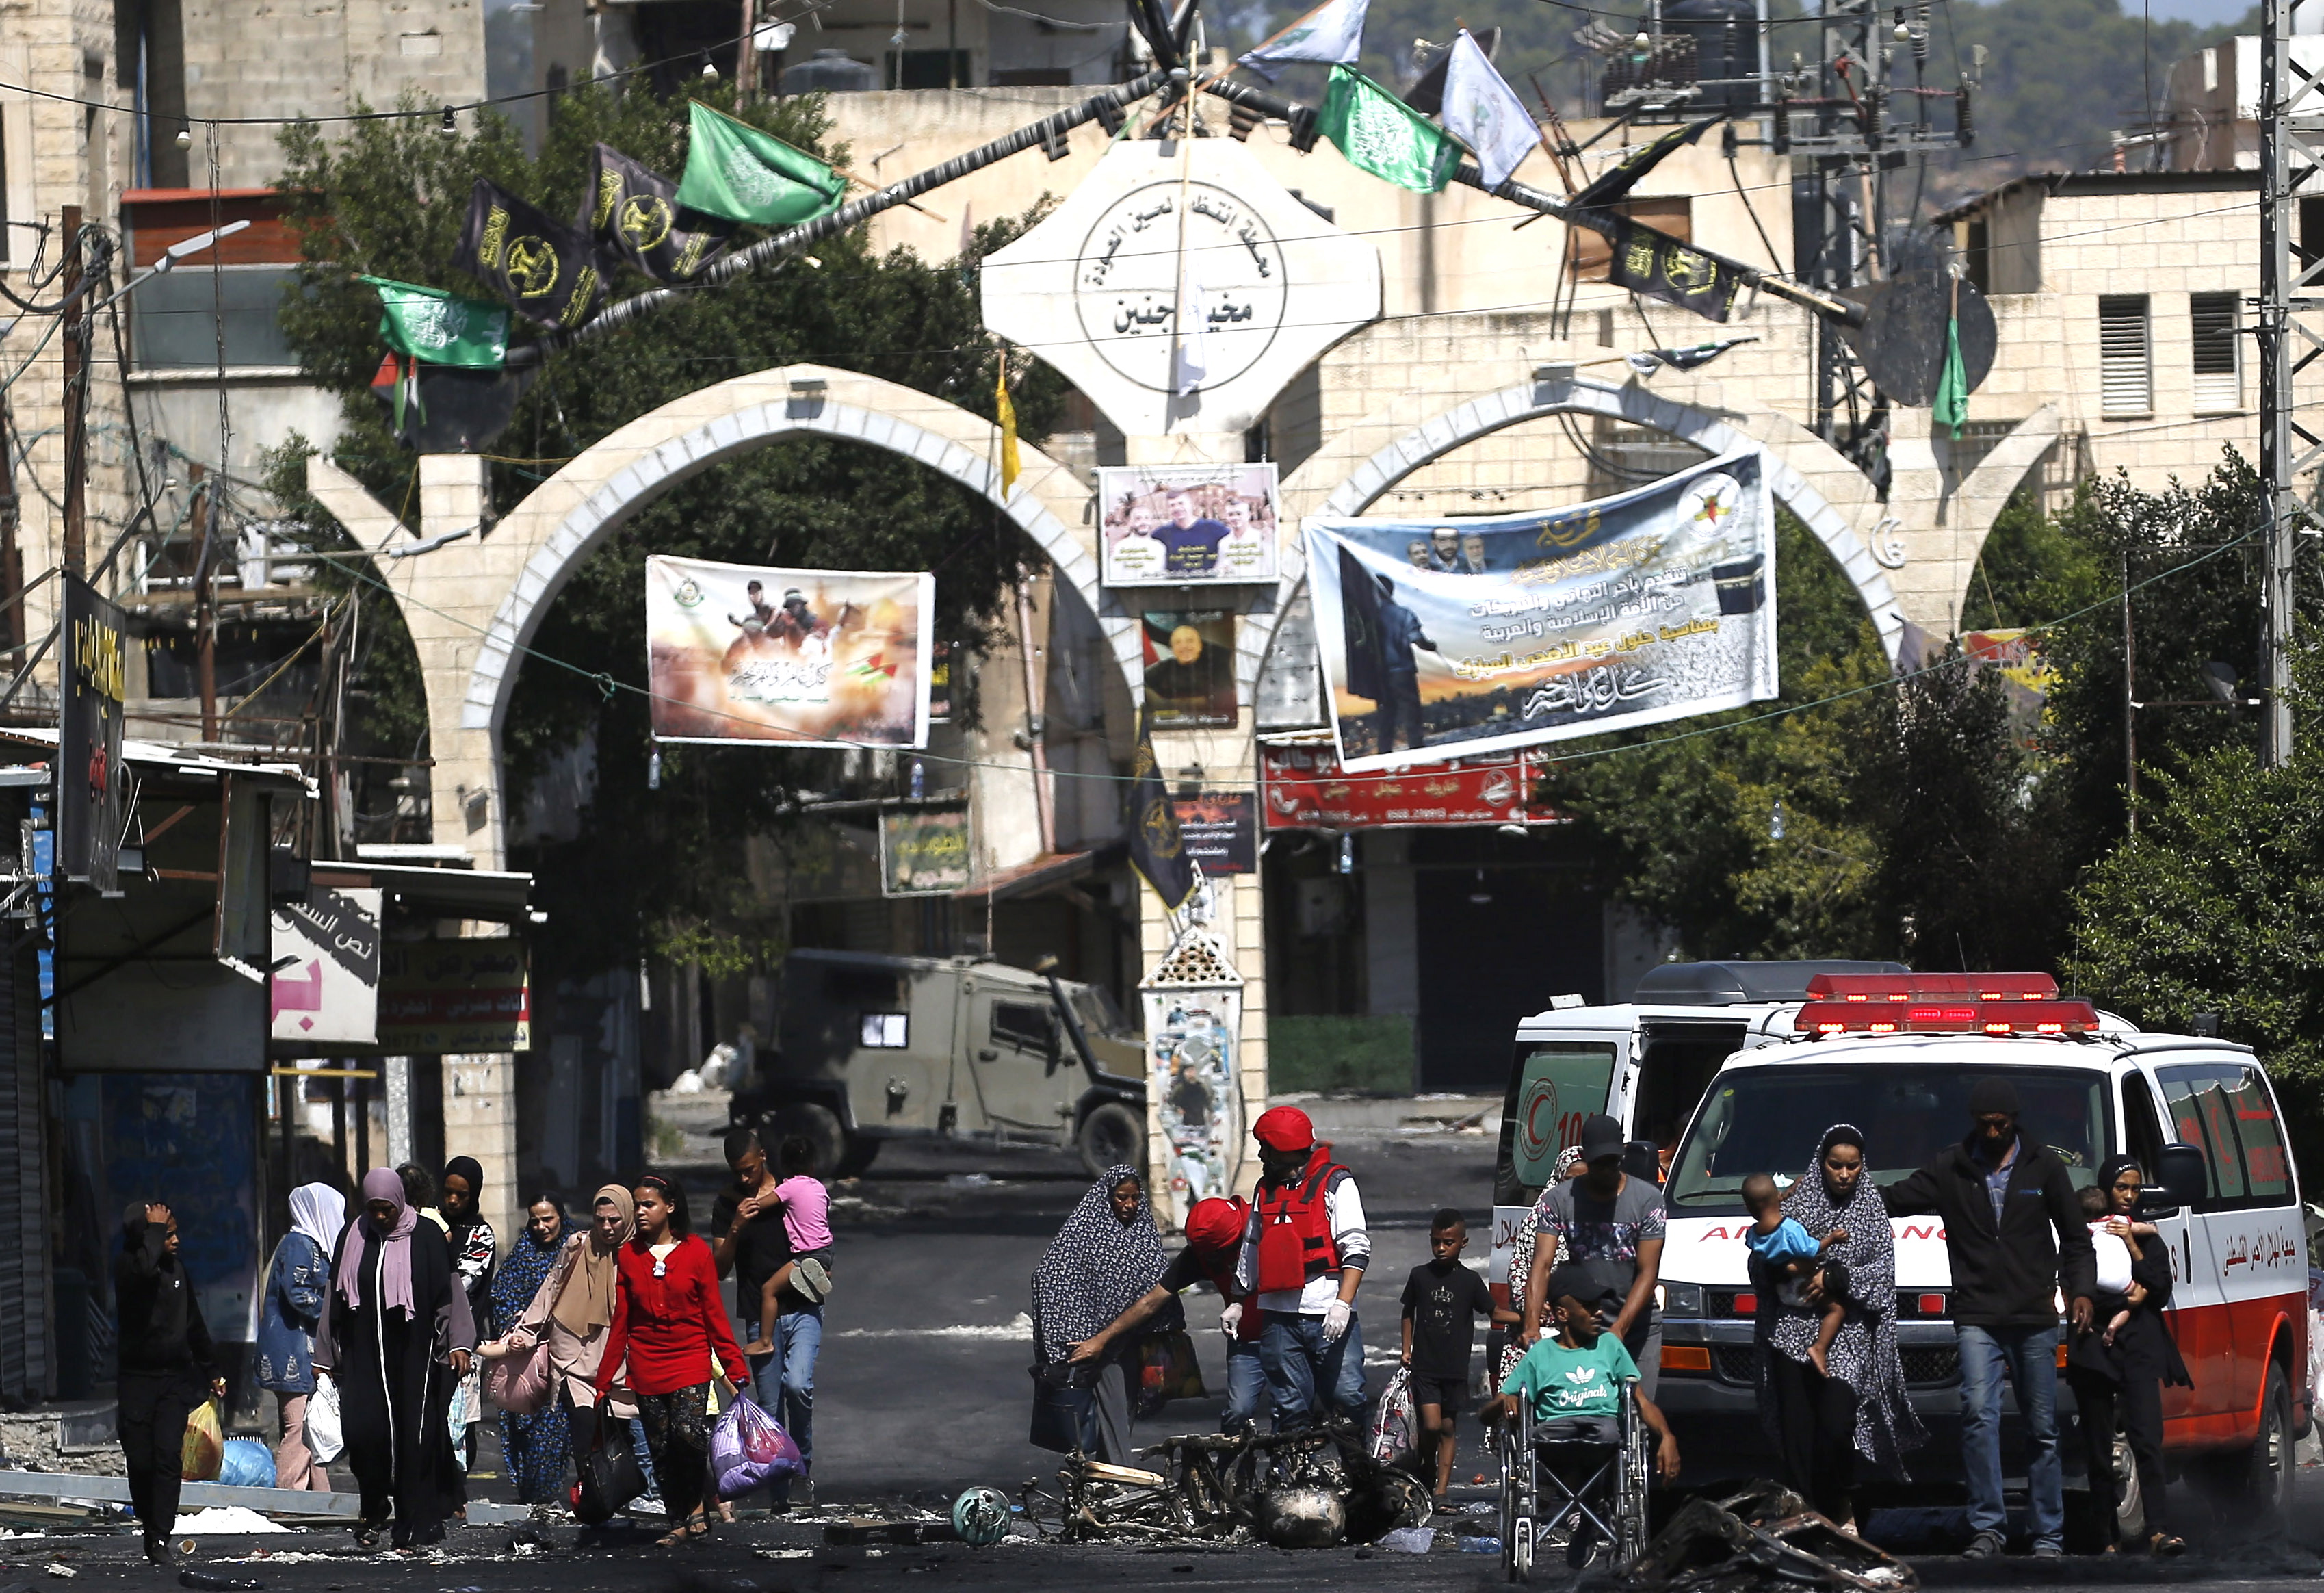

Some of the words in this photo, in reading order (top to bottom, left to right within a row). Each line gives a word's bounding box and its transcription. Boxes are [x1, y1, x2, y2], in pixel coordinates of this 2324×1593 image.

[1127, 196, 1174, 232] لحين
[1191, 194, 1238, 234] إنتظا
[1084, 224, 1128, 286] العودة
[1238, 218, 1271, 278] محطة
[1114, 294, 1175, 333] جنين
[1207, 292, 1252, 333] مخي
[1551, 581, 1608, 612] التهاني
[1612, 573, 1640, 598] بأحر
[1470, 594, 1550, 618] والتبريكات
[1619, 594, 1656, 618] الأمة
[1657, 594, 1685, 612] من
[1480, 617, 1543, 643] والعربية
[1548, 604, 1617, 634] الإسلامية
[1658, 617, 1720, 642] بمناسبة
[1516, 640, 1581, 671] الأضحى
[1583, 638, 1614, 658] عيد
[1615, 628, 1656, 653] حلول
[1455, 651, 1513, 679] المبارك
[286, 901, 339, 934] السع
[334, 933, 373, 961] نص
[1558, 1111, 1595, 1151] 10
[2250, 1227, 2265, 1271] الأحمر
[2266, 1230, 2280, 1269] الهلال
[2281, 1225, 2295, 1266] جمعية
